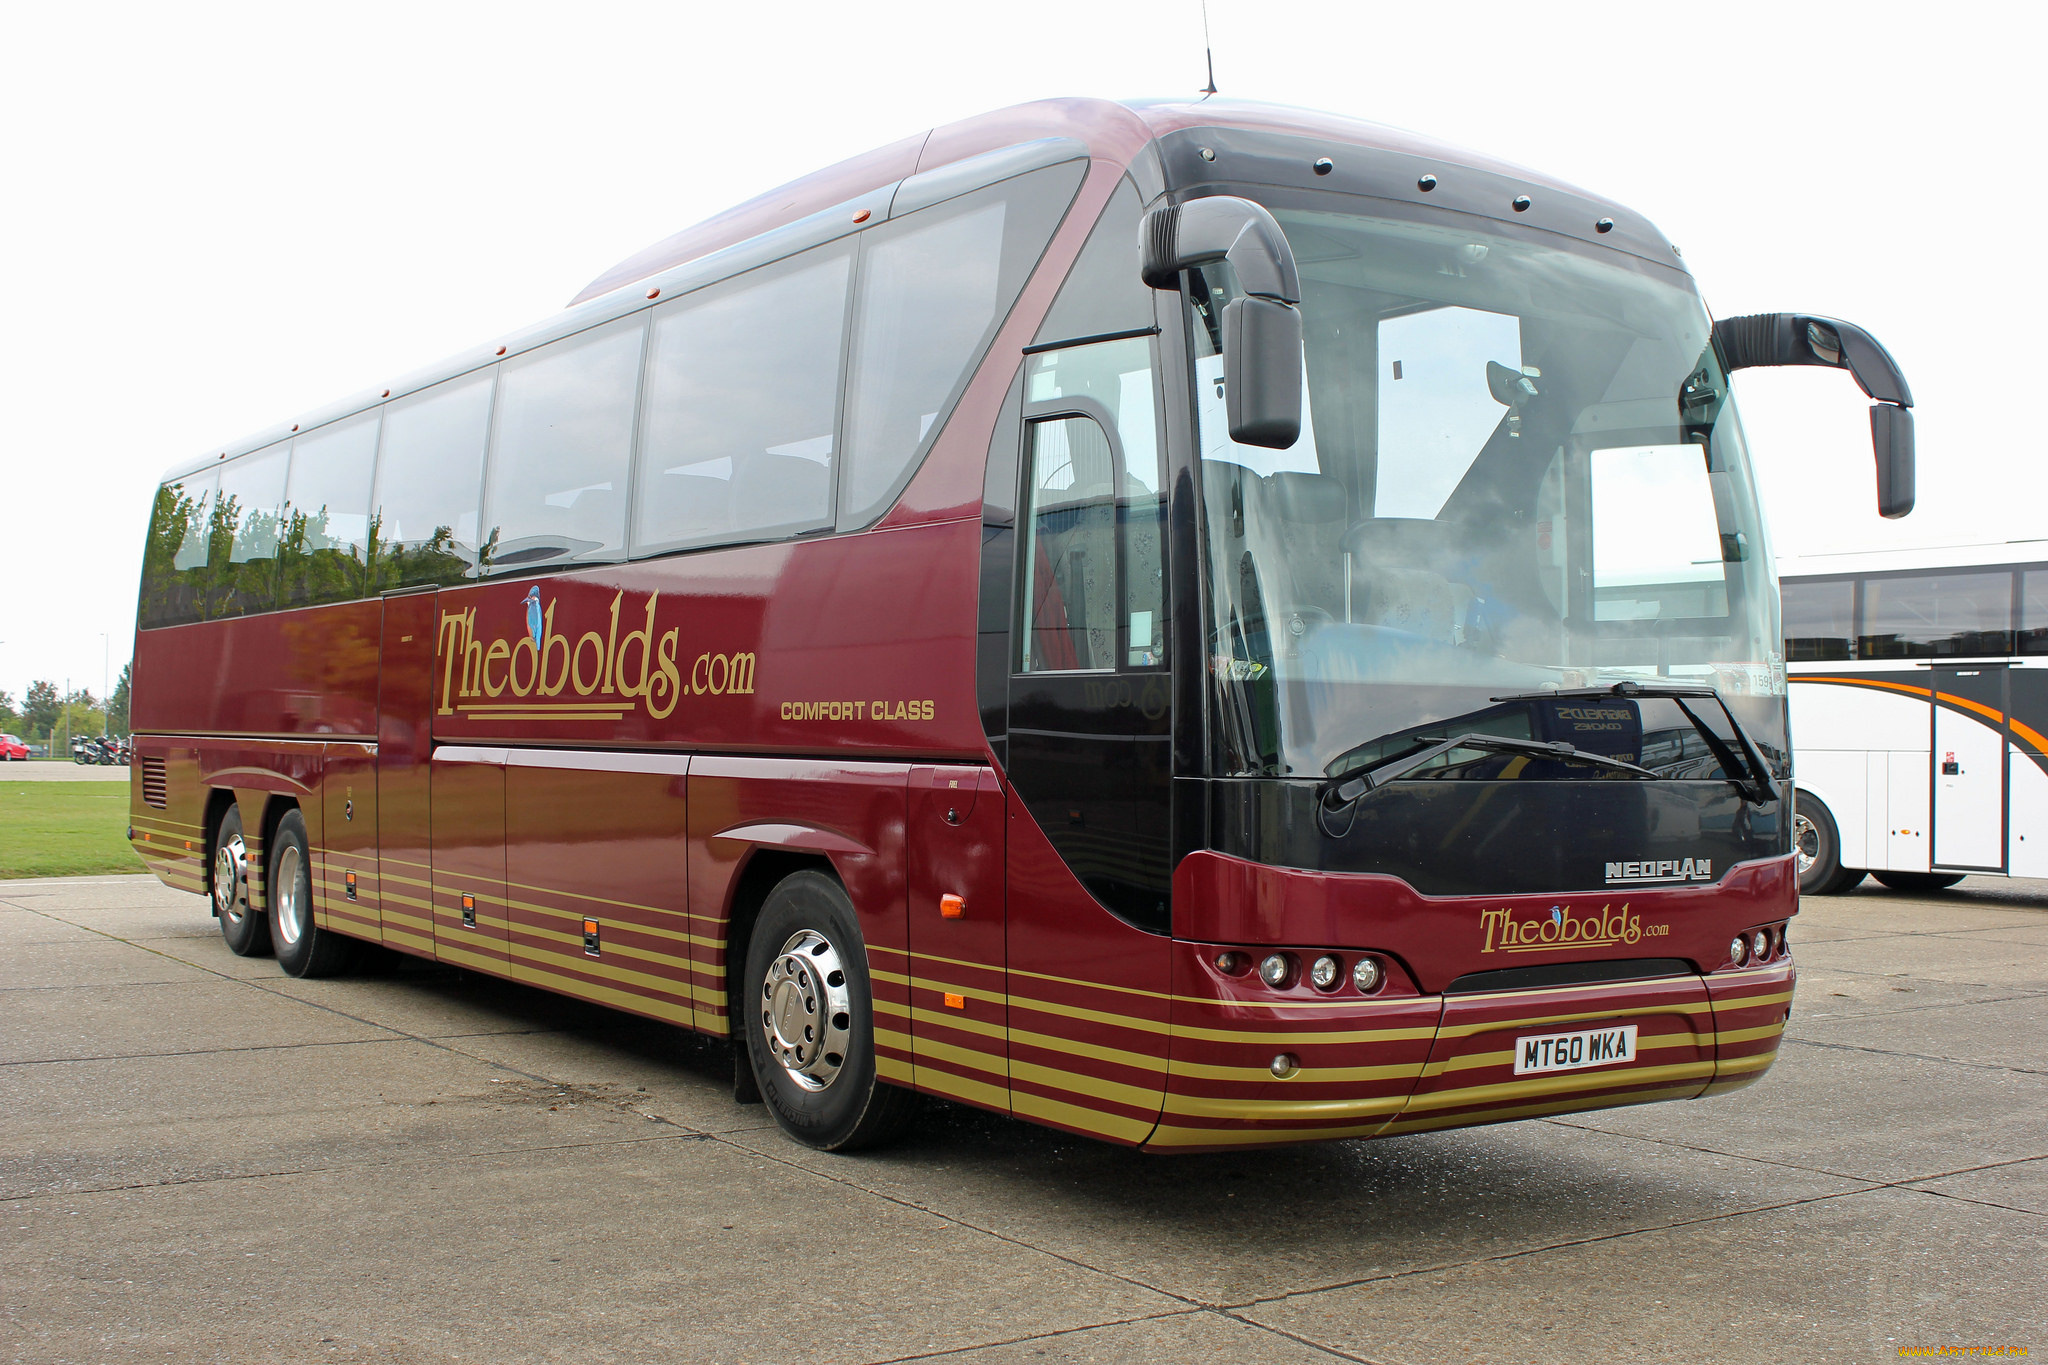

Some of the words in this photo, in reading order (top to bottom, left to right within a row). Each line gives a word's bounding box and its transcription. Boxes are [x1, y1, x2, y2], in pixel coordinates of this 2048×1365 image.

[437, 587, 755, 720] Theobolds.com
[781, 701, 865, 721] COMFORT
[871, 700, 935, 720] CLASS
[1605, 858, 1711, 882] NEOPLAN
[1480, 903, 1669, 953] Theobolds.com
[1524, 1036, 1583, 1068] MT60
[1589, 1031, 1627, 1061] WKA
